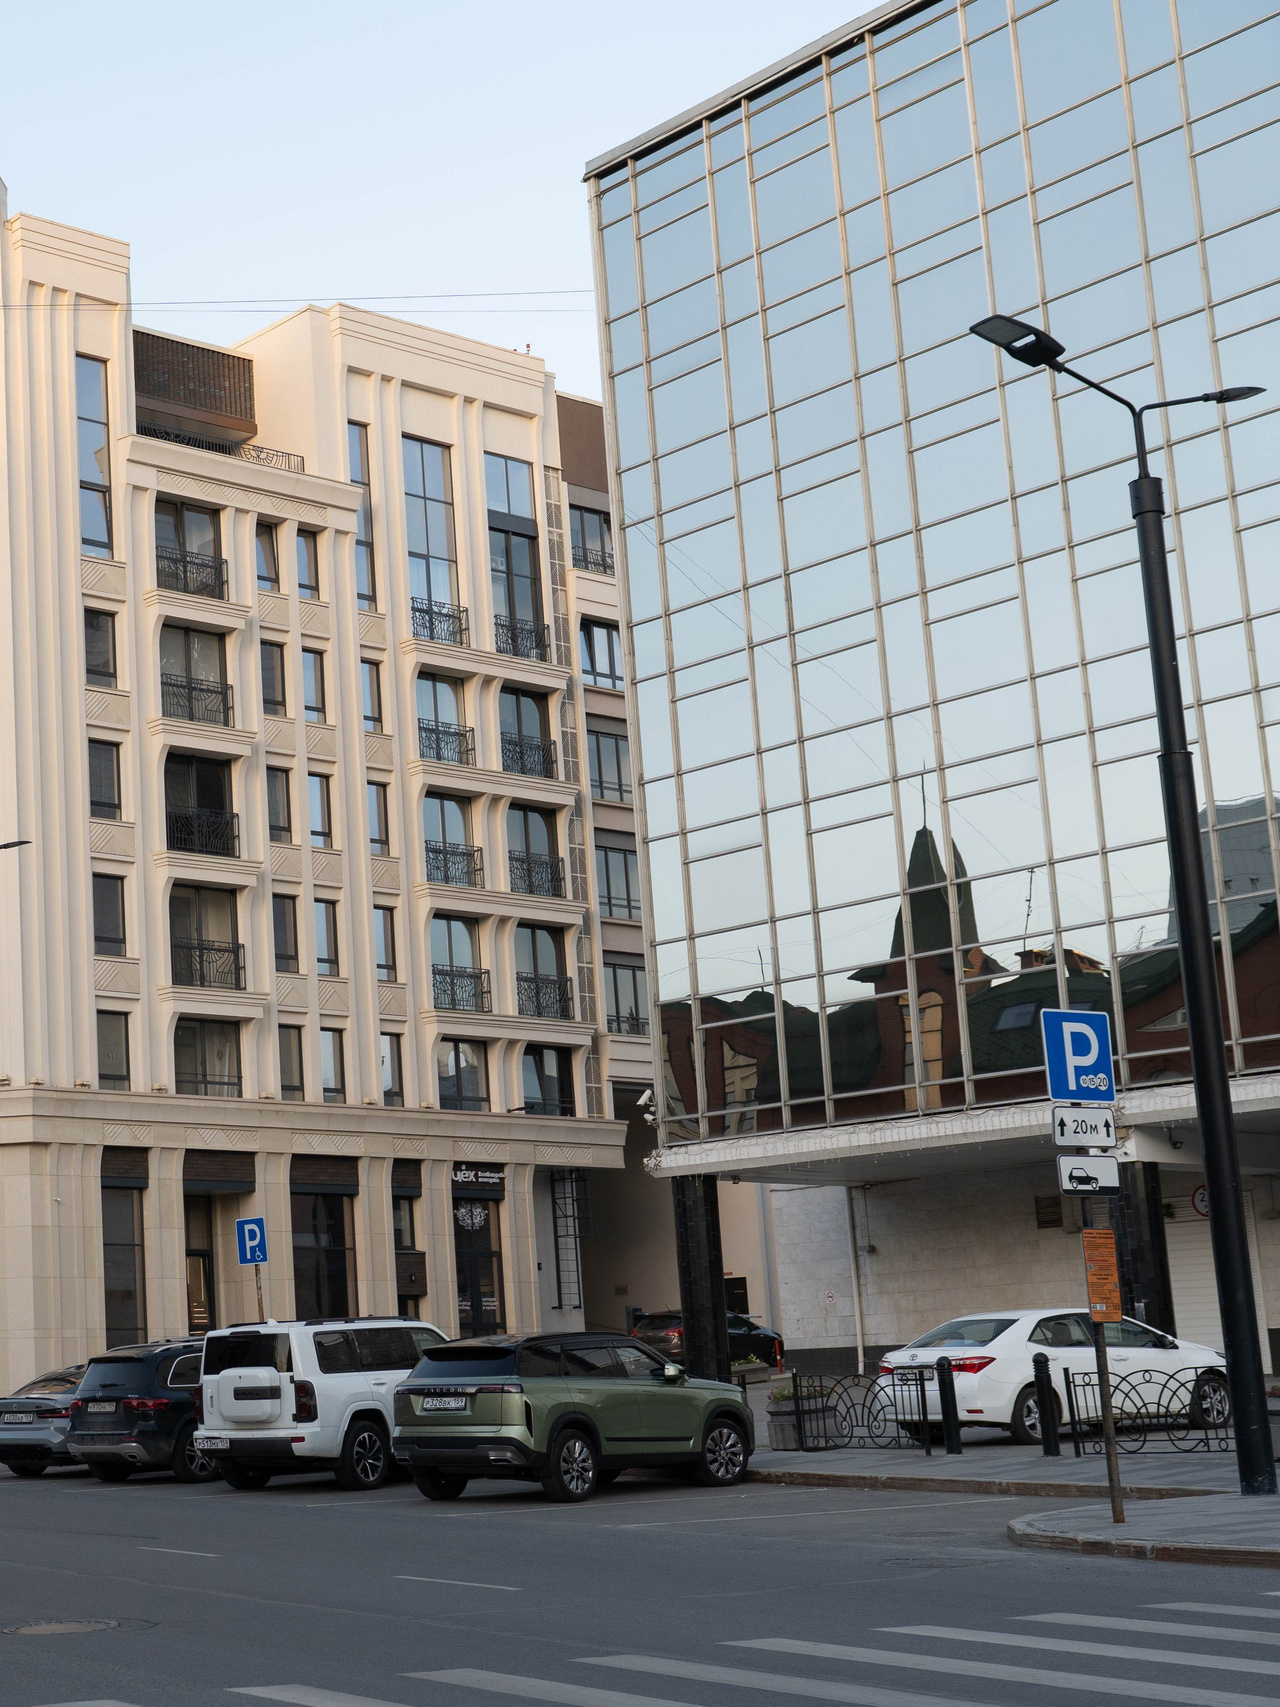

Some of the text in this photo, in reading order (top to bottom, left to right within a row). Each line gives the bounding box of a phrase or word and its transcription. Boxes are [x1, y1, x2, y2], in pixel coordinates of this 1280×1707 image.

[1062, 1022, 1099, 1090] P
[1088, 1077, 1096, 1086] 15
[1097, 1076, 1108, 1088] 20
[244, 1224, 260, 1260] P
[425, 1398, 451, 1407] Р328ВК
